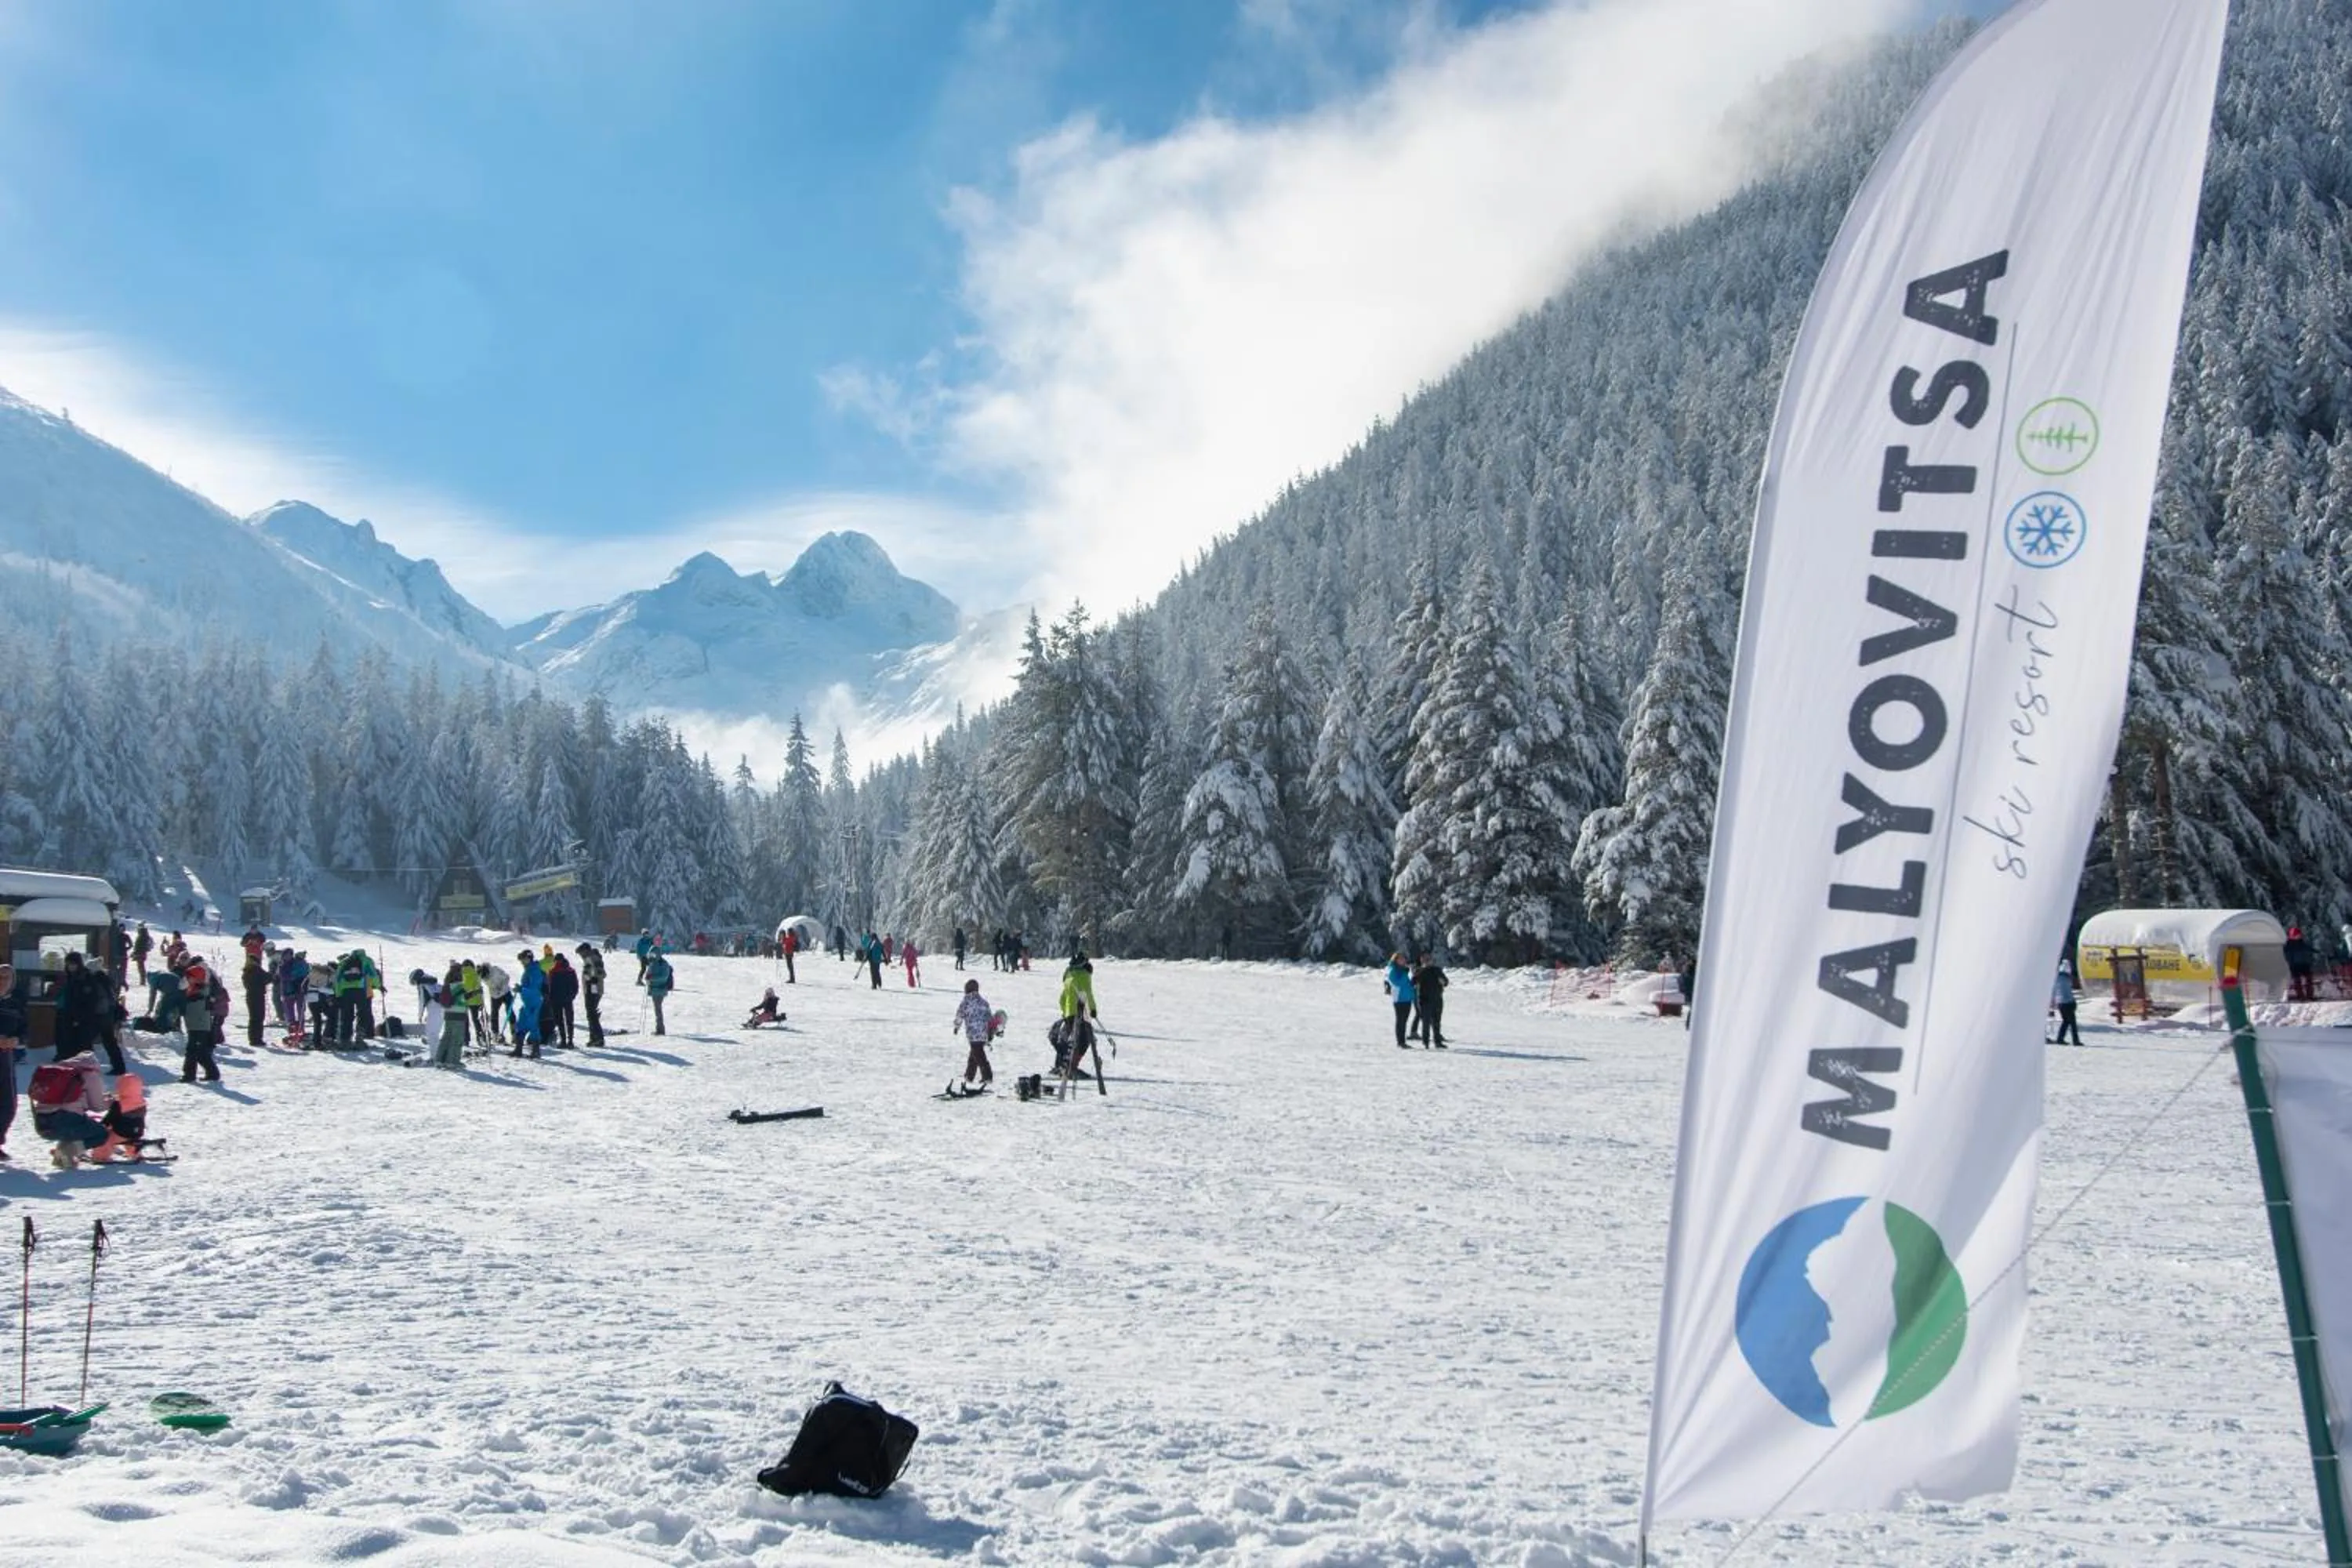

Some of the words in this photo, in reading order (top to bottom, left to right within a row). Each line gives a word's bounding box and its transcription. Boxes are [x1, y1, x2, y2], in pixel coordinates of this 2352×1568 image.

[1802, 249, 2009, 1151] MALYOVITSA
[1994, 584, 2058, 766] resort
[1962, 785, 2032, 880] ski
